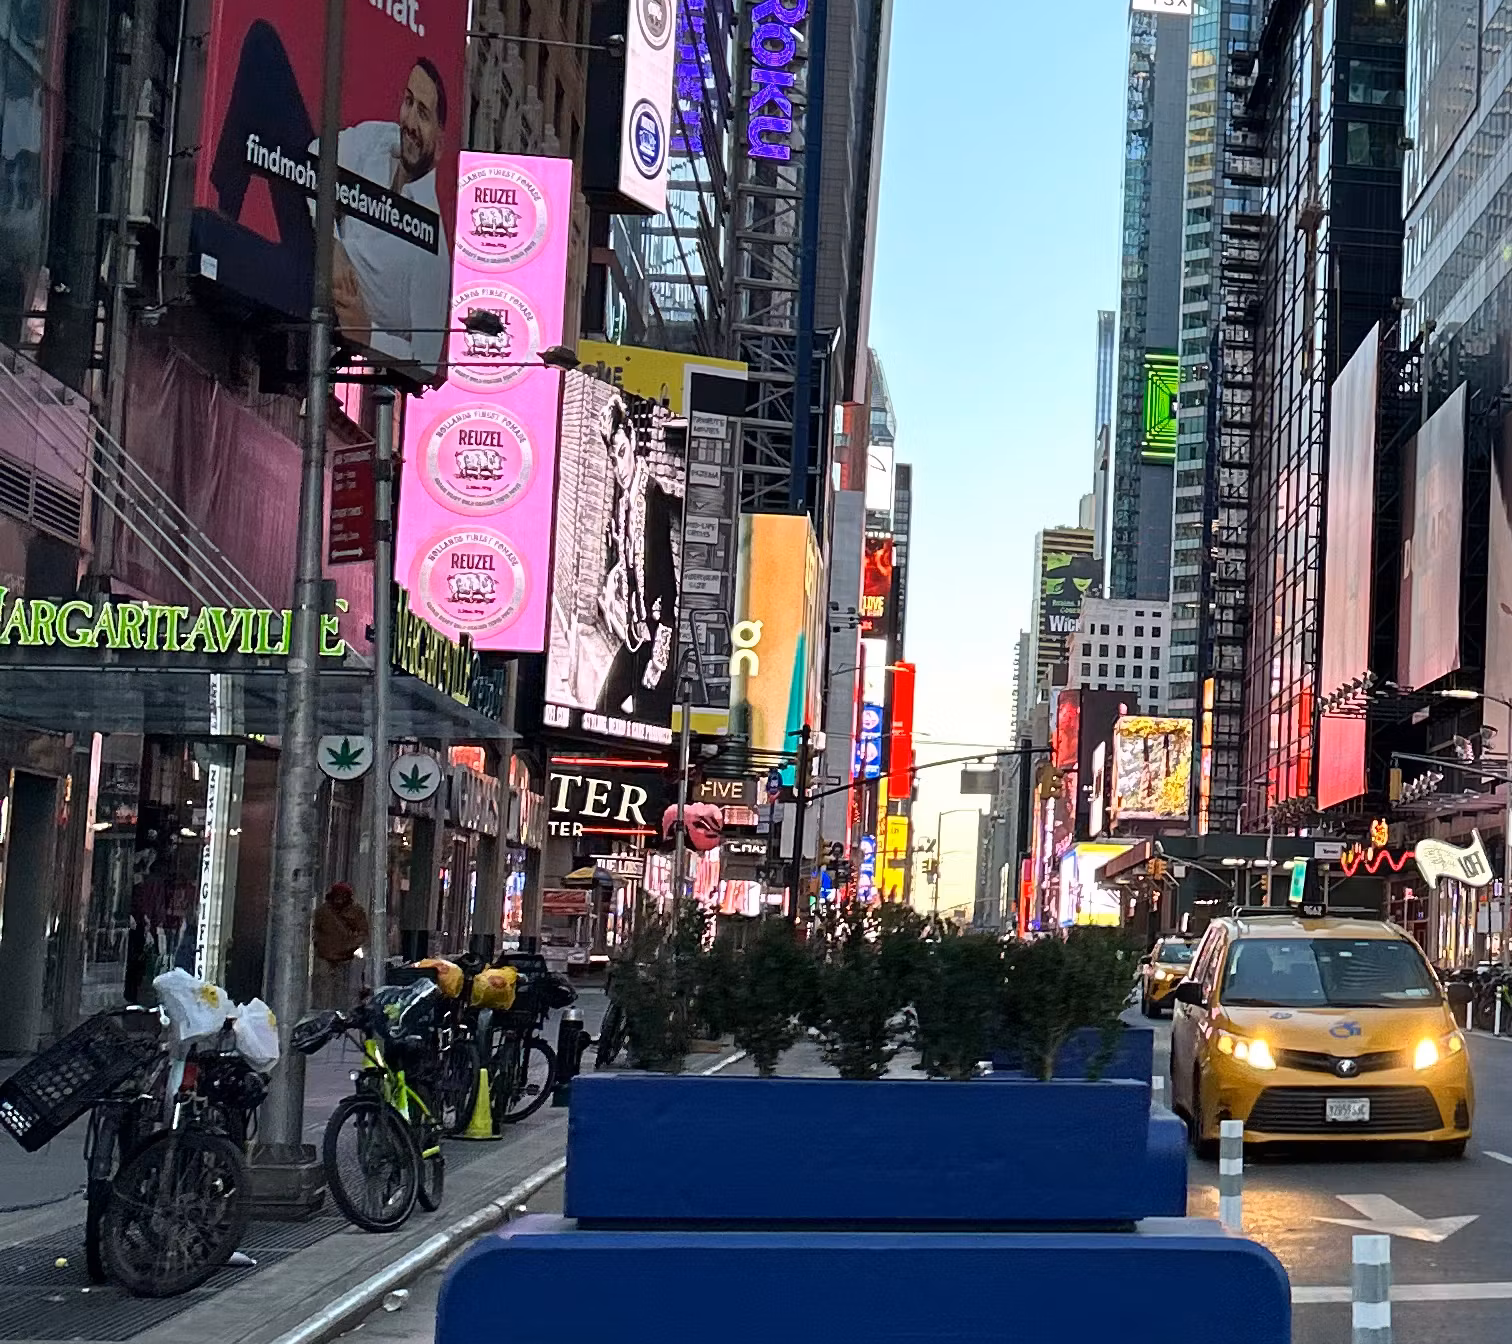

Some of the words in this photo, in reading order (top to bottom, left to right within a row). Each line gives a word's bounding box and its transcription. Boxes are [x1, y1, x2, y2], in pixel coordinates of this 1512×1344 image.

[246, 133, 434, 245] findmohedawife.com
[474, 187, 519, 206] REUZEL
[458, 429, 504, 448] REUZEL
[451, 553, 496, 572] REUZEL
[0, 585, 349, 657] ARGARITAVILLE
[550, 772, 648, 825] TER
[700, 781, 744, 799] FIVE
[548, 821, 584, 838] TER
